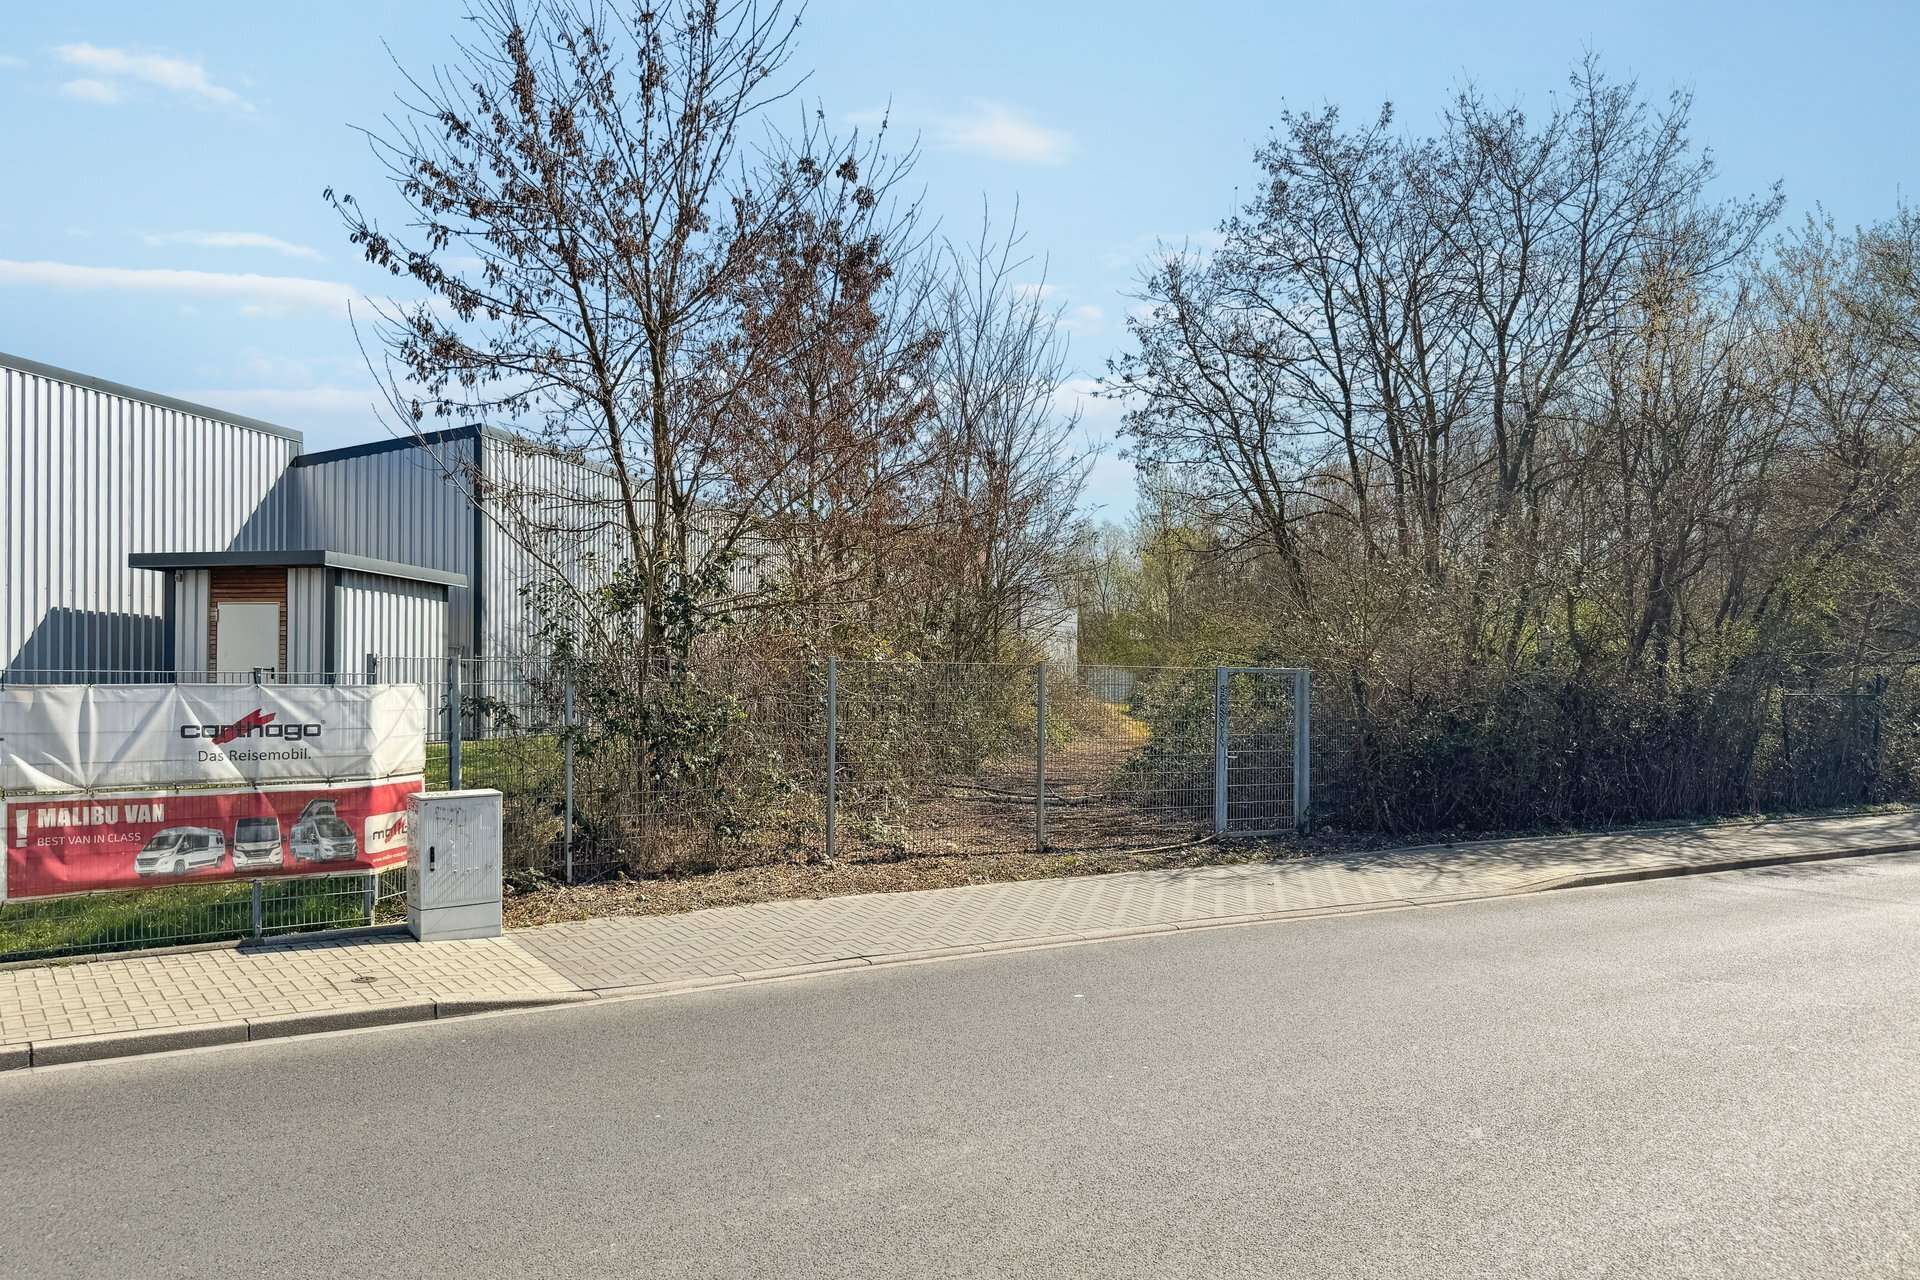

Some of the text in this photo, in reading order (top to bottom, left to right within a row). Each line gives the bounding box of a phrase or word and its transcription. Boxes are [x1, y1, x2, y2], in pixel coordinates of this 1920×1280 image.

[180, 719, 322, 741] carthago
[198, 748, 312, 762] Das Reisemobil.
[37, 803, 165, 829] MALIBU VAN
[37, 832, 142, 847] BEST VAN IN CLASS
